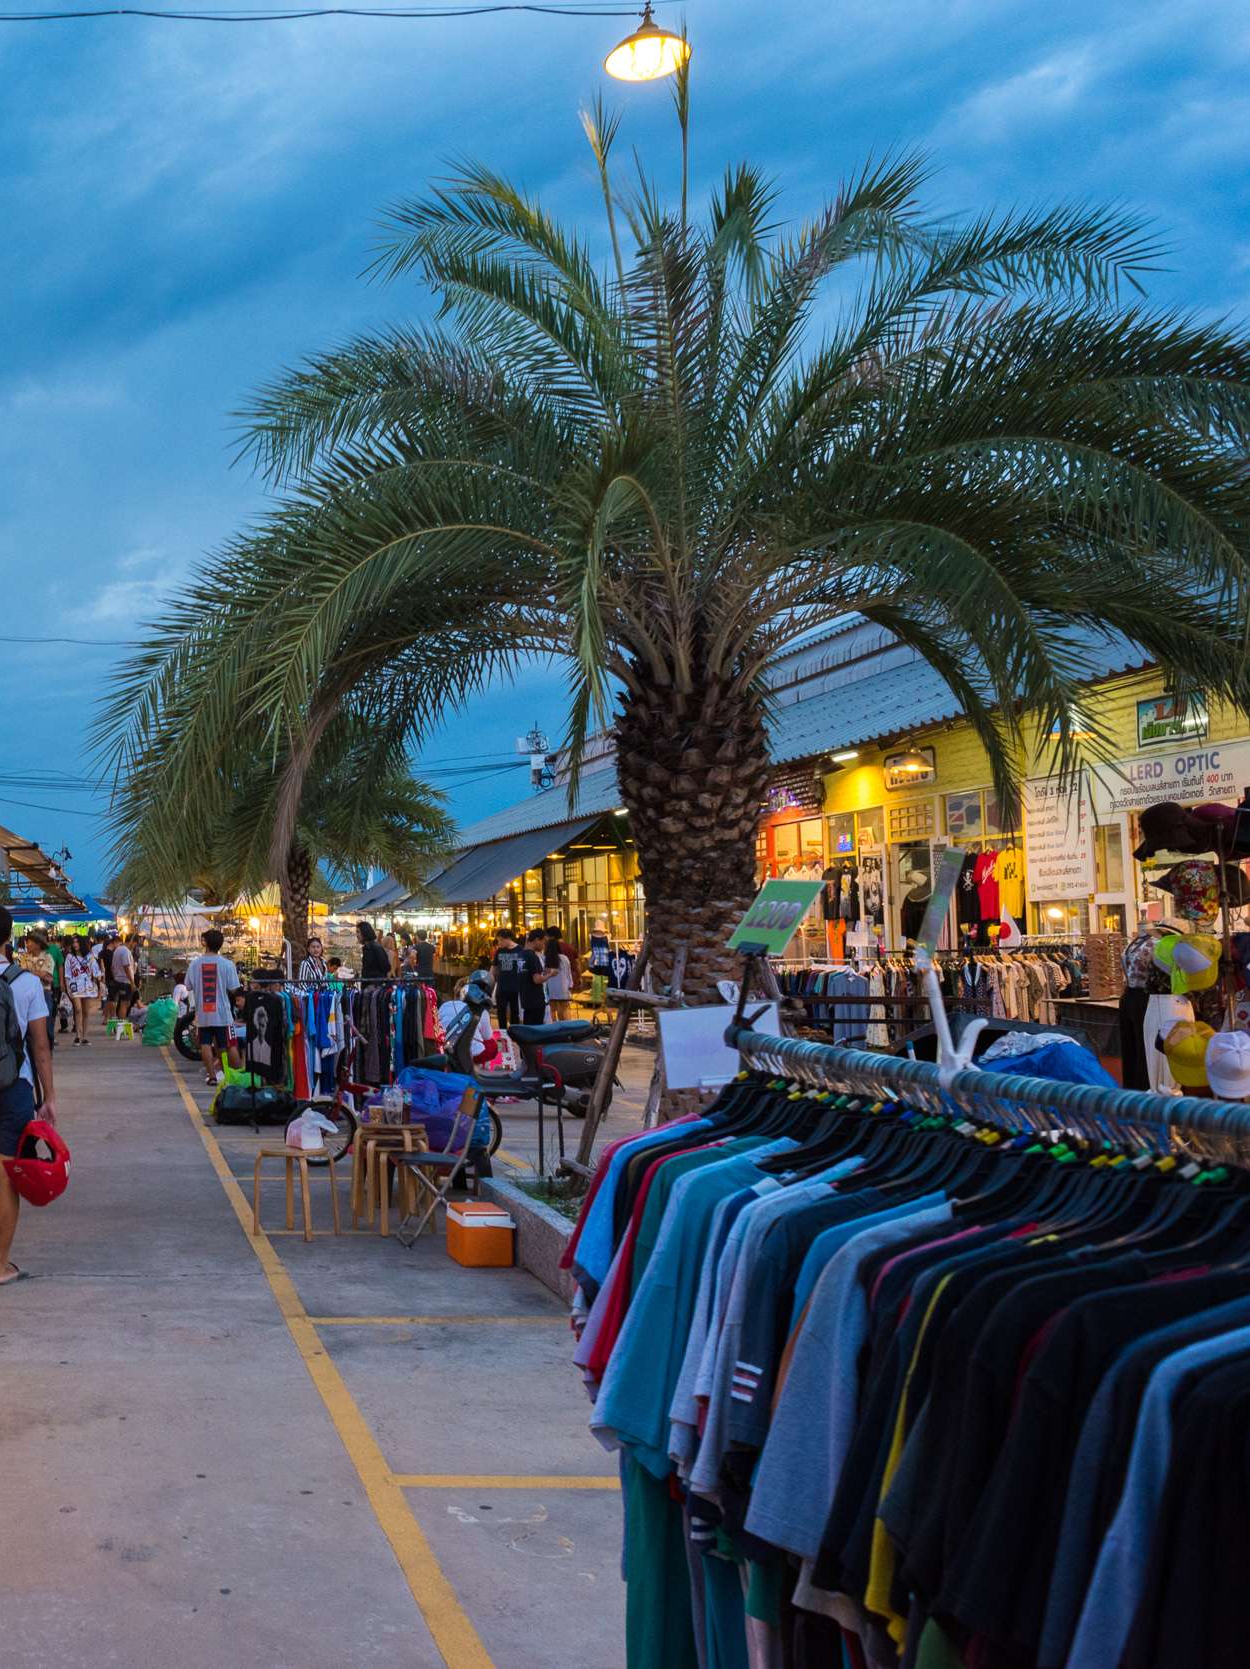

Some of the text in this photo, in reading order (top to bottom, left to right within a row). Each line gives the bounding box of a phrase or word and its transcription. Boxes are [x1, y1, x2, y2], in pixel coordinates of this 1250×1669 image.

[1130, 751, 1220, 781] LERD OPTIC
[1206, 773, 1220, 784] 400
[1221, 772, 1234, 782] บาท
